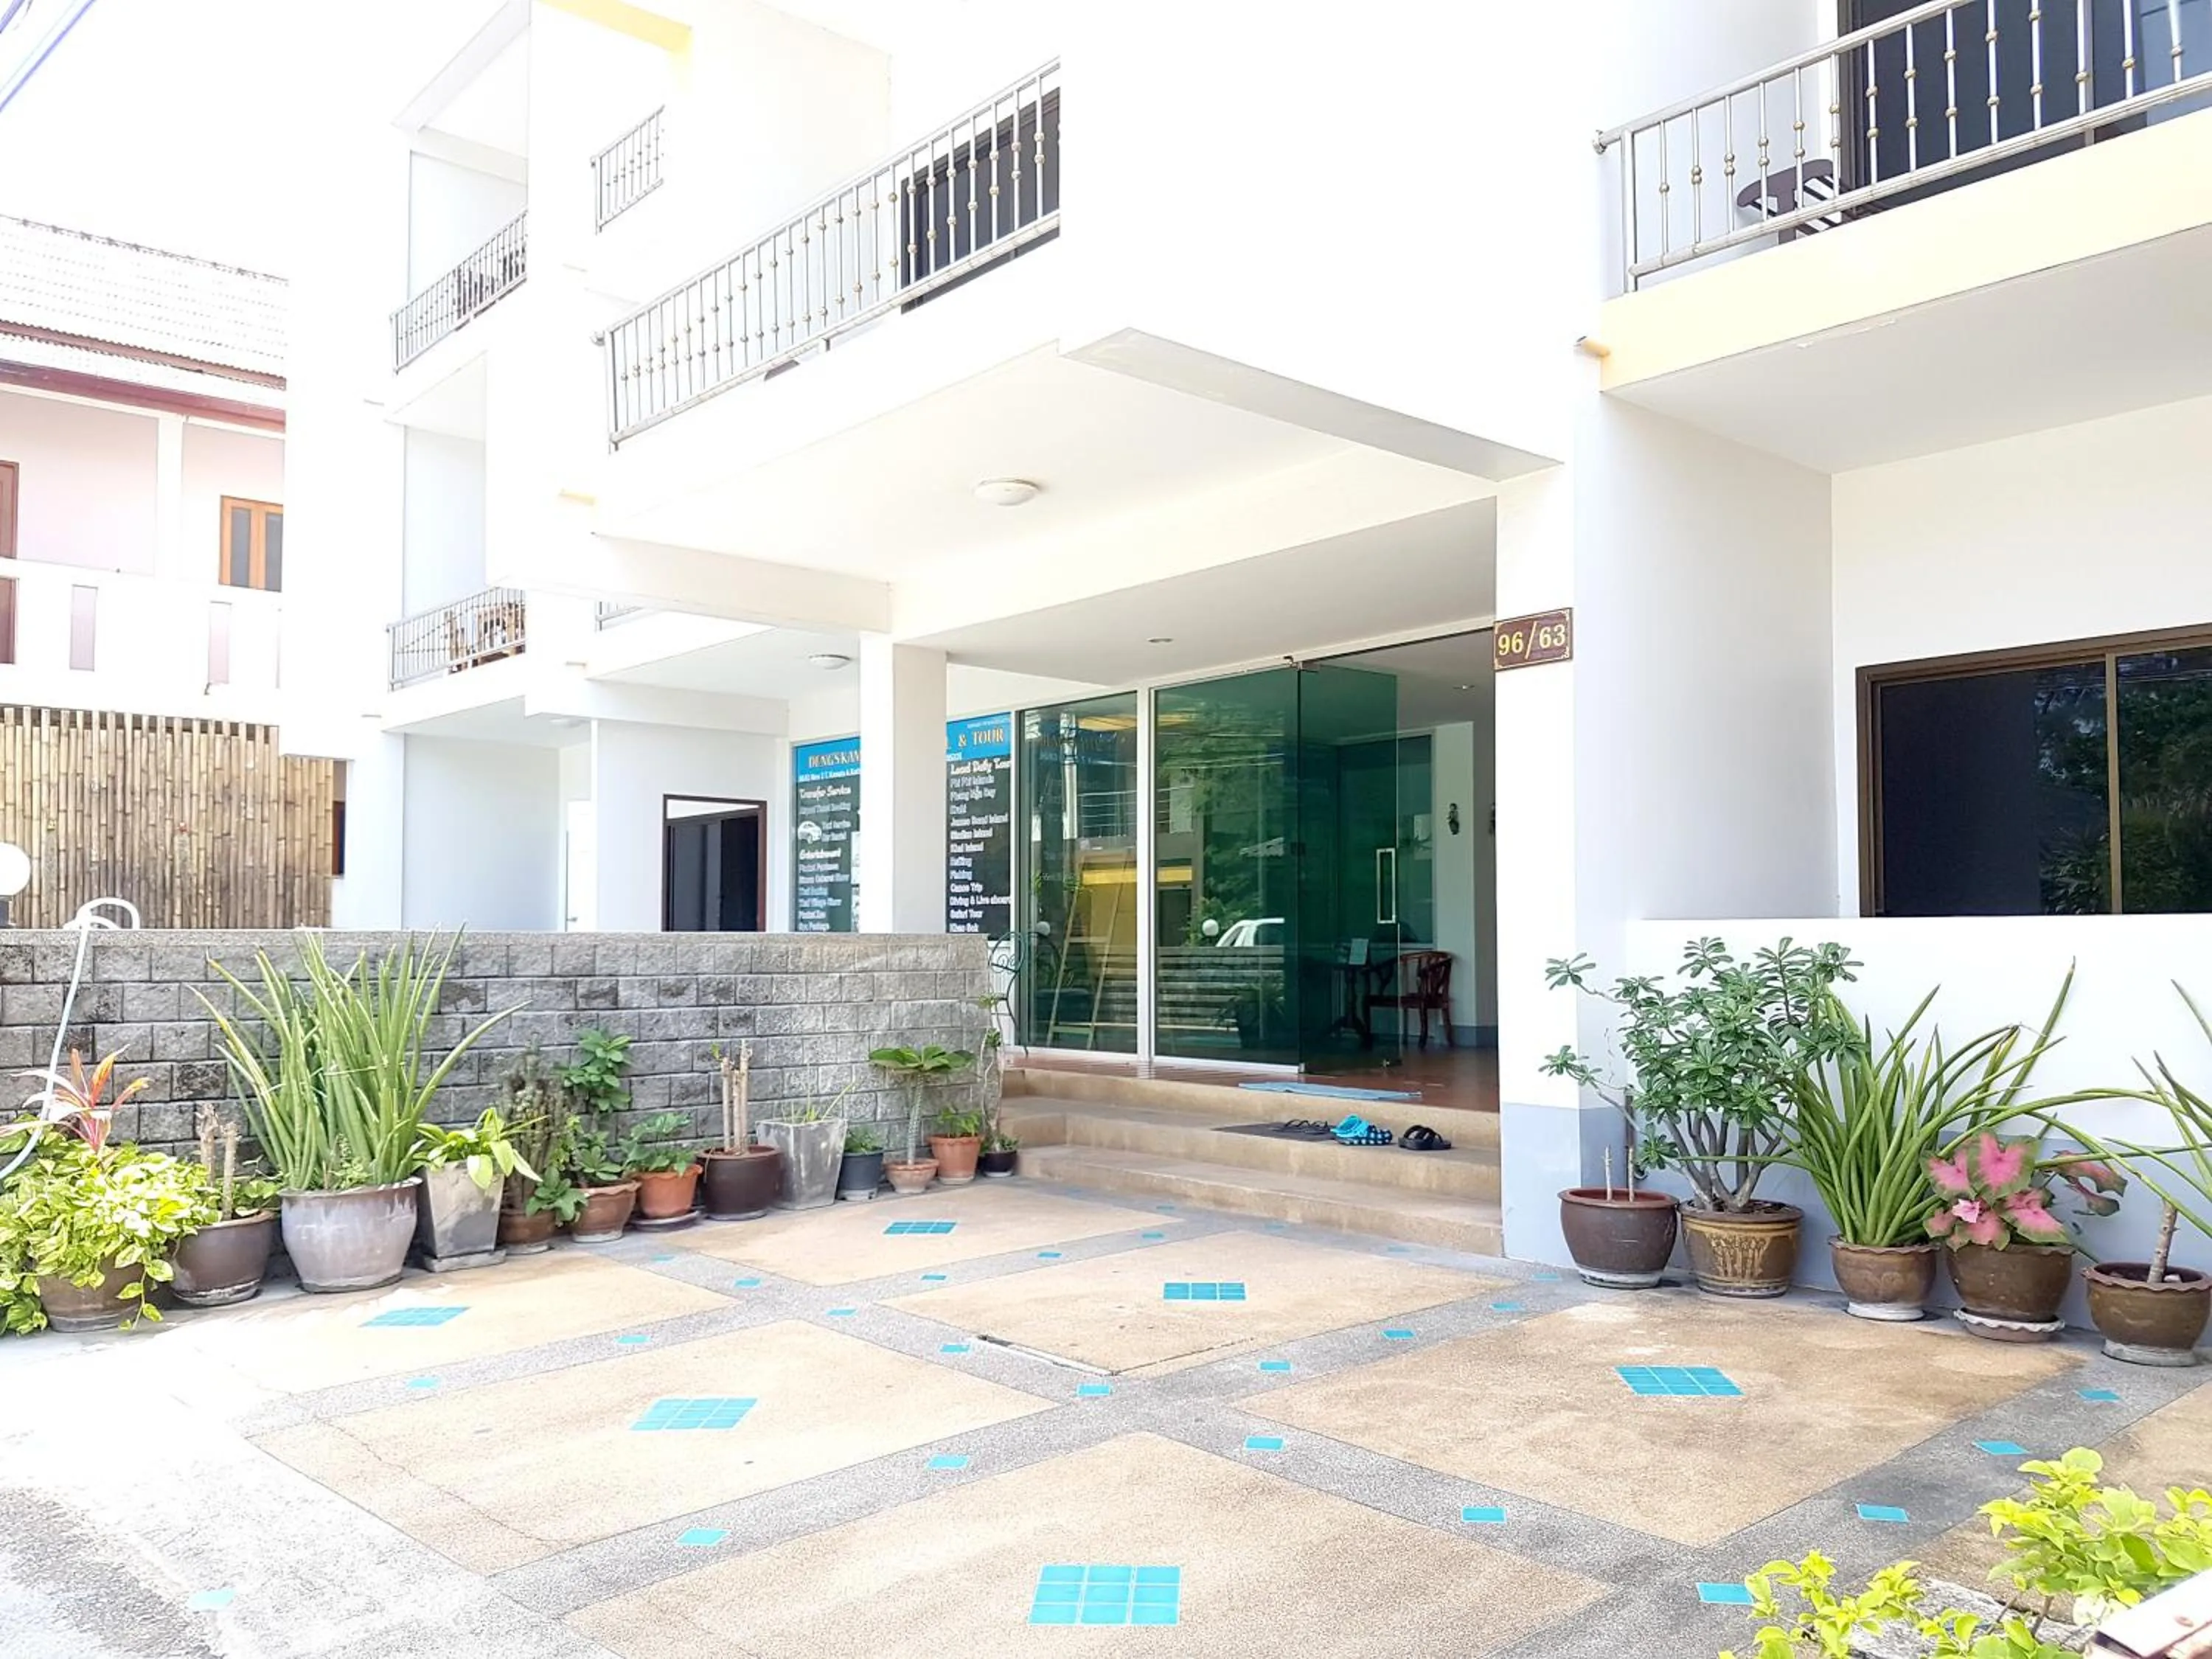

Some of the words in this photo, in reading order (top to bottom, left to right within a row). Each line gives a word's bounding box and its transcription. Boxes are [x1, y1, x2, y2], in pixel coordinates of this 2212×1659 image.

[1498, 621, 1565, 660] 96/63
[958, 733, 967, 748] &
[973, 727, 1004, 746] TOUR
[950, 762, 971, 775] Local
[972, 758, 992, 774] Daily
[970, 882, 984, 894] Trip
[970, 895, 975, 905] &
[968, 908, 984, 919] Tour
